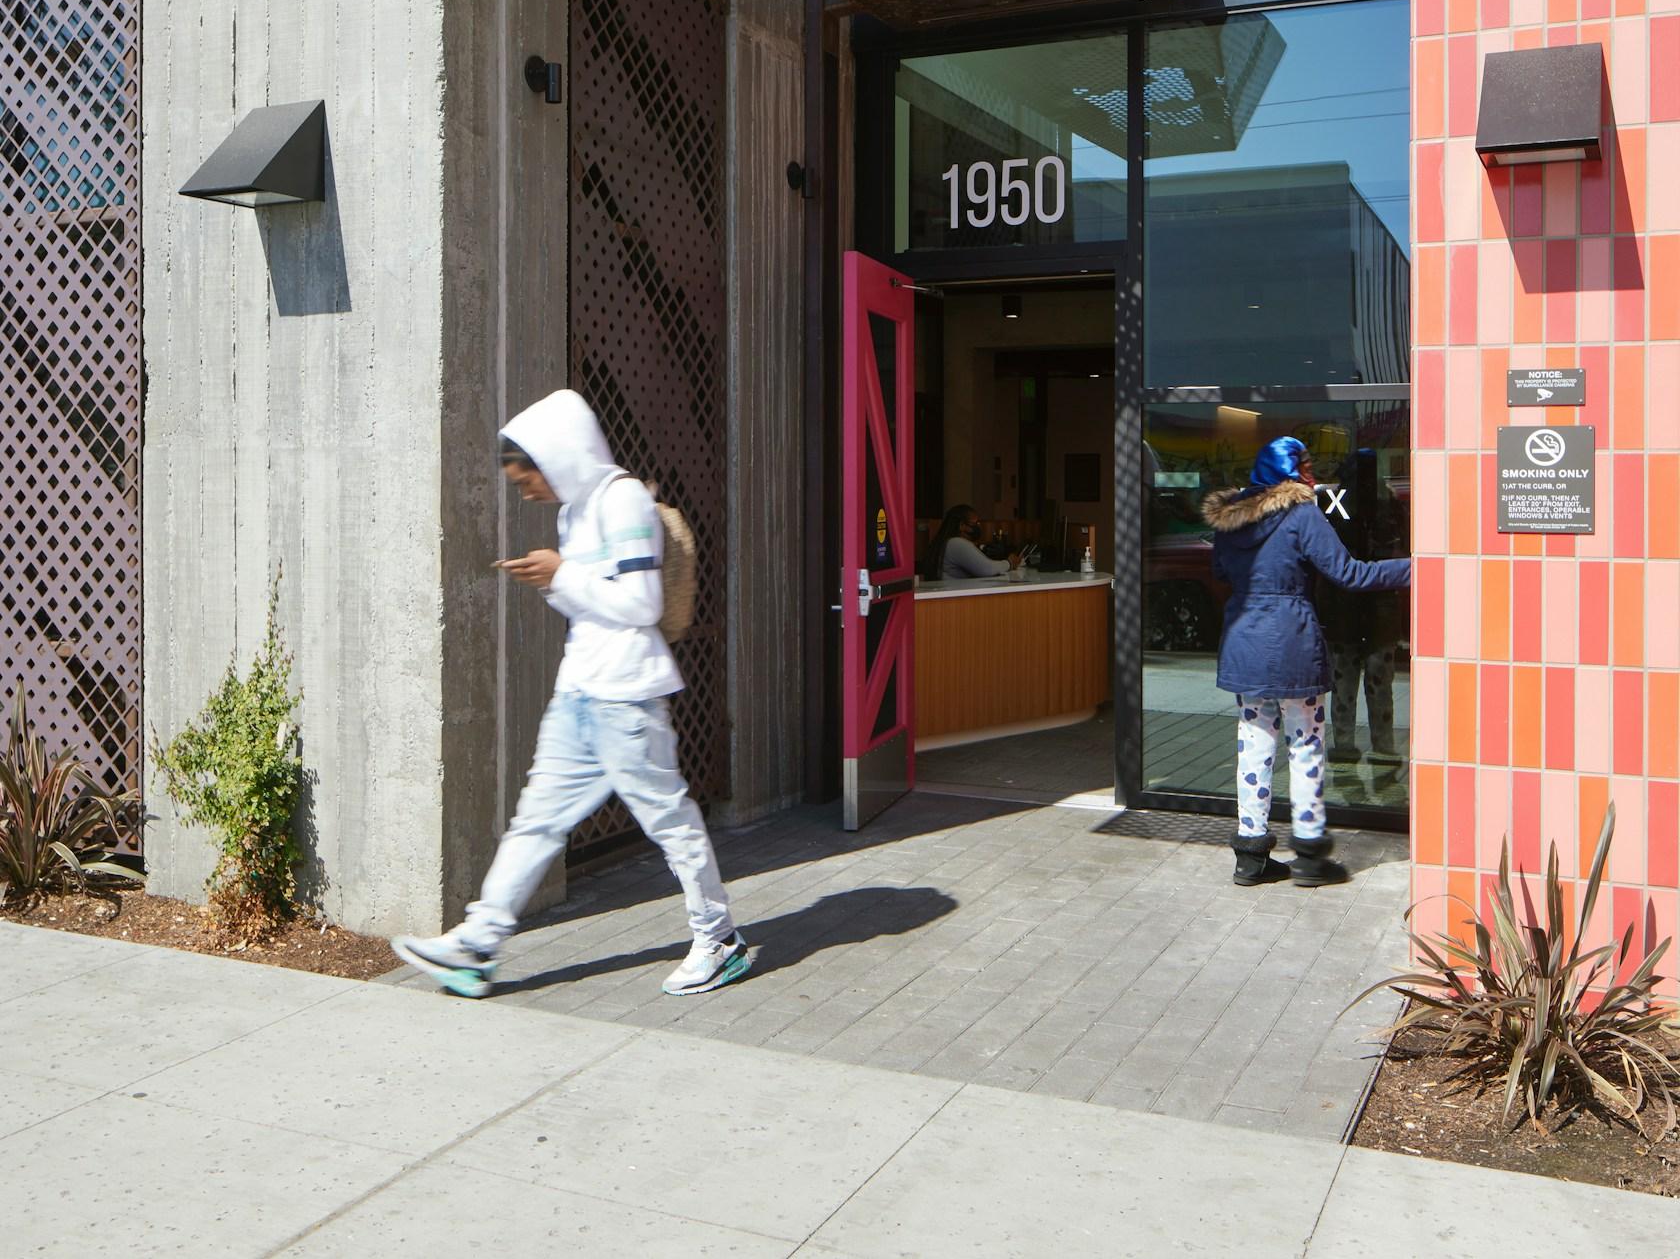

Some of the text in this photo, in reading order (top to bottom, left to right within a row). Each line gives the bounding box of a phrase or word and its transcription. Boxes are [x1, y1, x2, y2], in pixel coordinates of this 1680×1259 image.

[942, 155, 1065, 229] 1950
[1502, 469, 1589, 478] SMOKING ONLY
